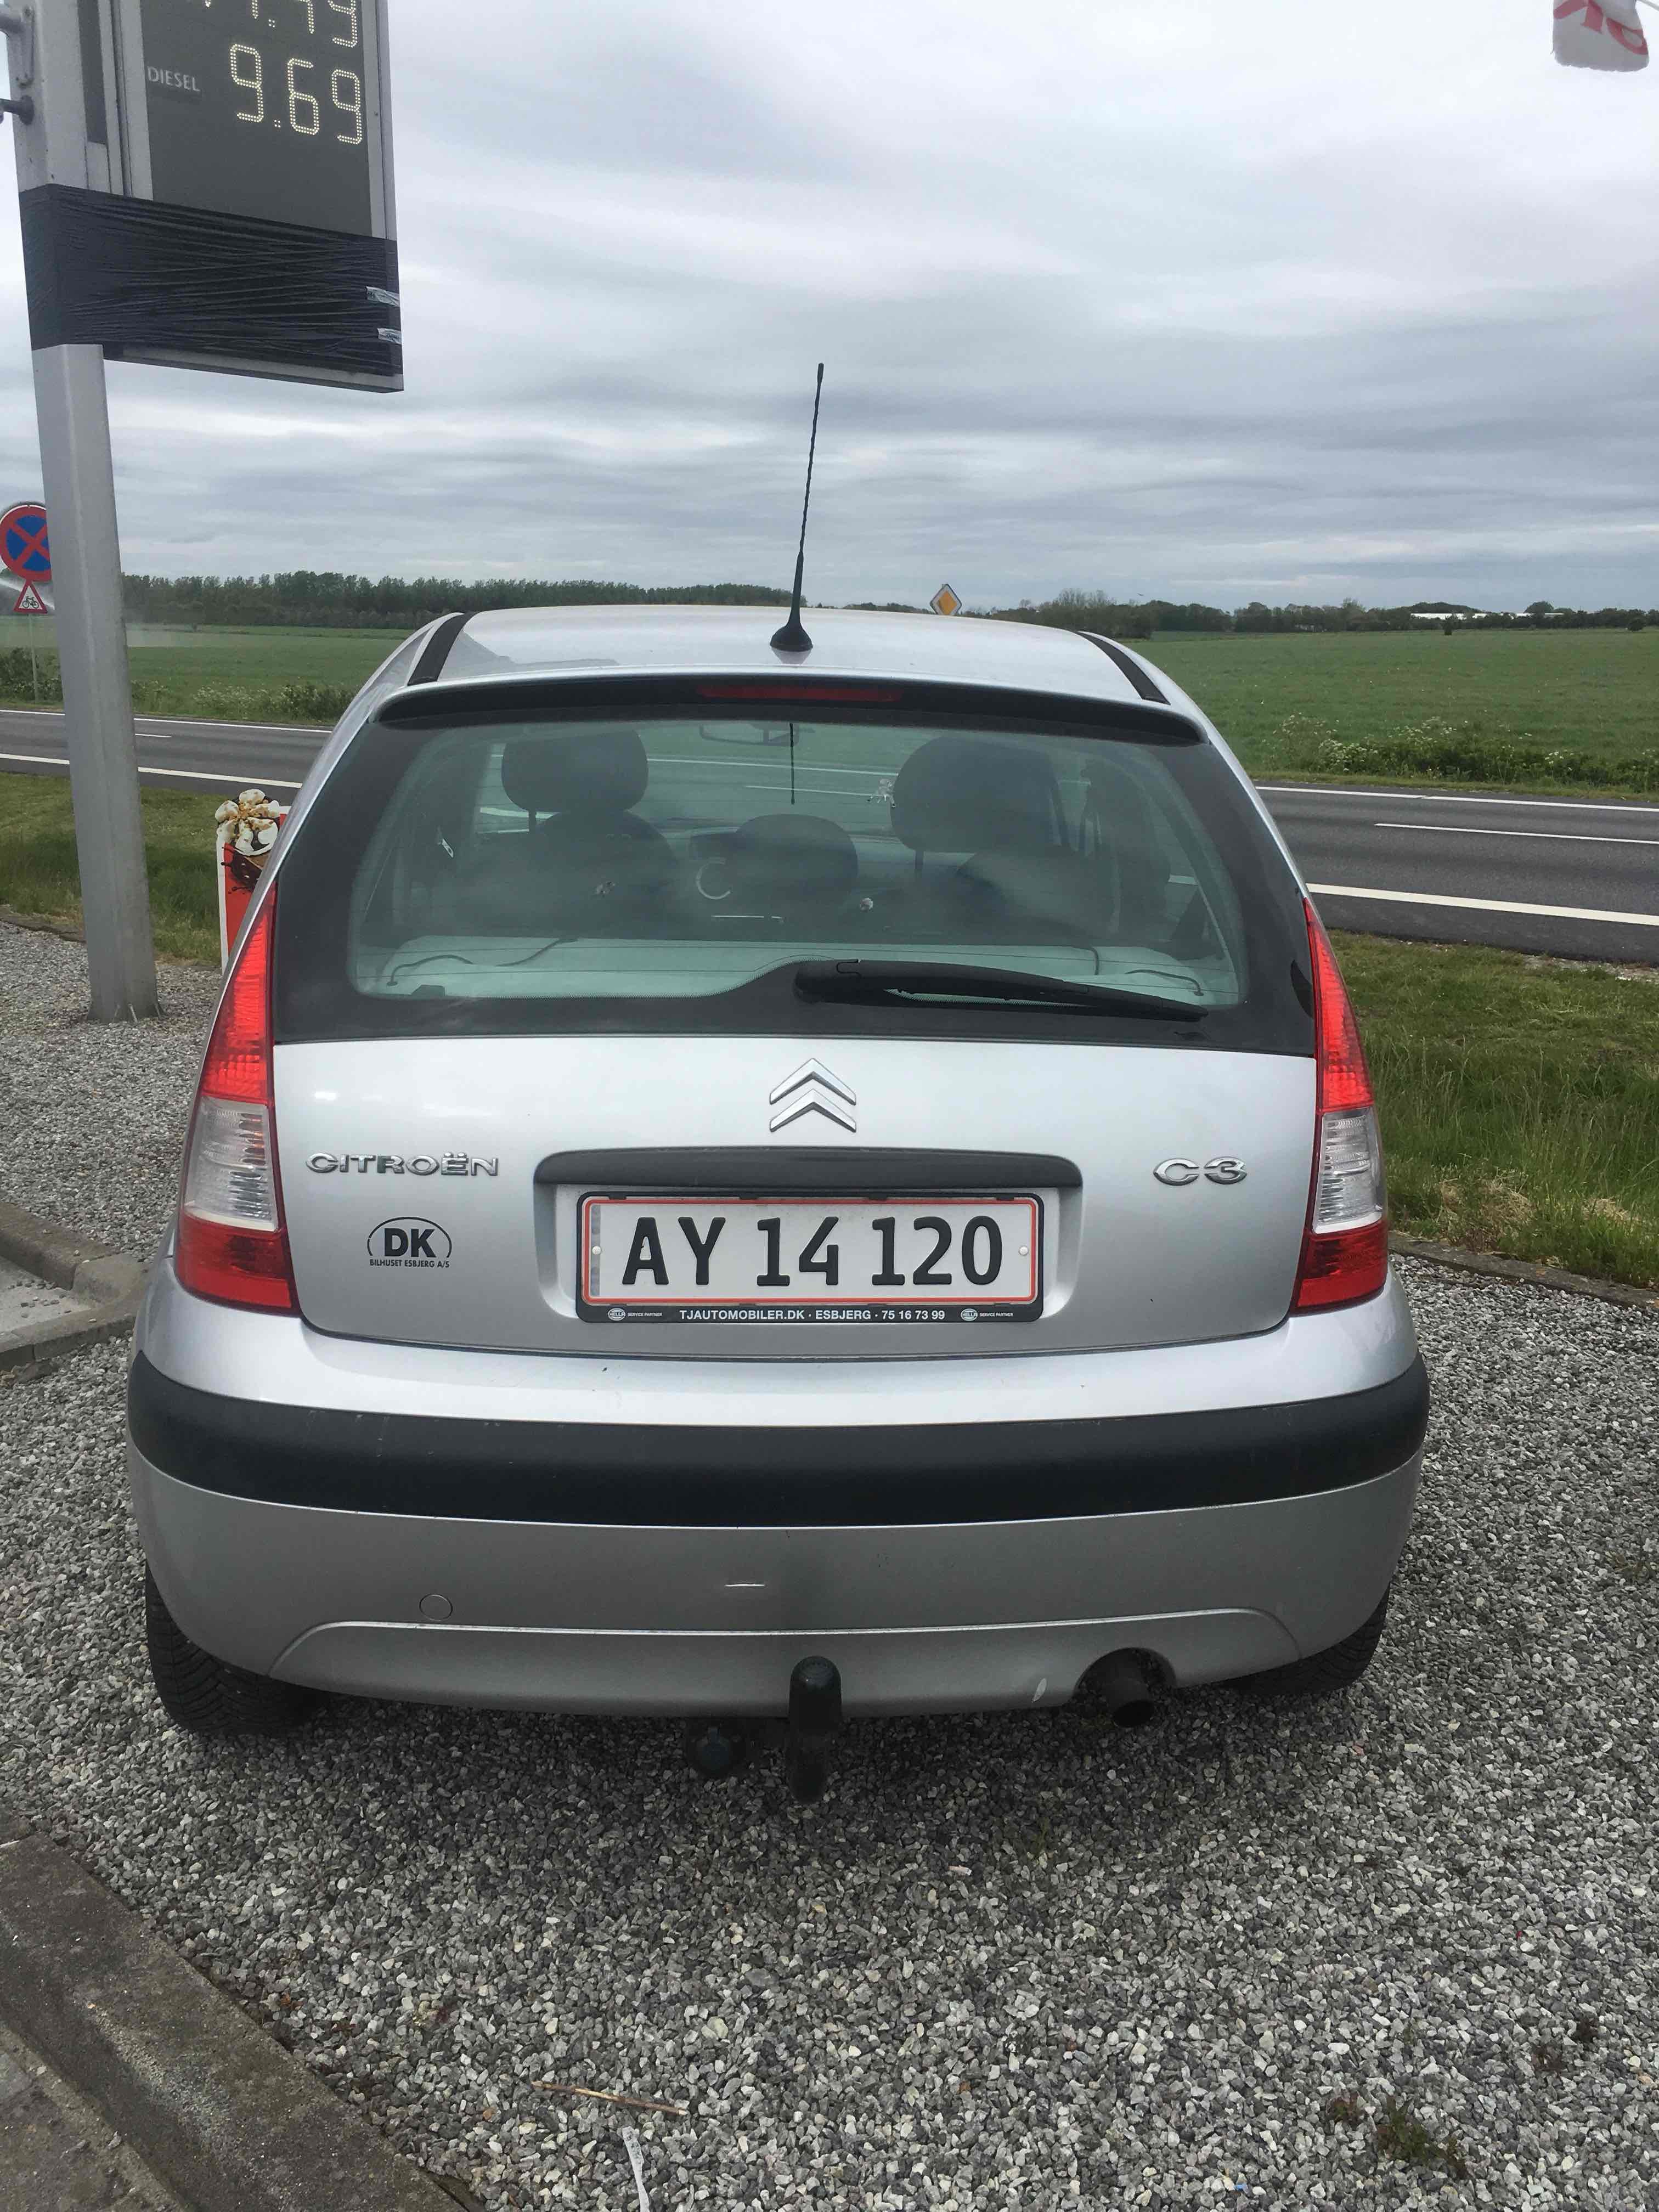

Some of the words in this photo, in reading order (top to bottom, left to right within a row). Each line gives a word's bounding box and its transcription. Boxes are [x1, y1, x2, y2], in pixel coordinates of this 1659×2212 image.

[147, 66, 201, 92] DIESEL
[230, 43, 363, 145] 9.69
[306, 1152, 498, 1176] CITROËN
[1153, 1156, 1248, 1186] C3
[384, 1228, 437, 1258] DK
[622, 1216, 726, 1285] AY
[757, 1216, 839, 1286] 14
[871, 1215, 1003, 1286] 120
[404, 1260, 435, 1268] ESBJERG
[679, 1310, 805, 1320] TJAUTOMOBILER.DK
[815, 1310, 871, 1320] ESBJERG
[882, 1310, 895, 1320] 75
[899, 1310, 912, 1320] 16
[915, 1310, 929, 1320] 73
[932, 1310, 945, 1320] 99
